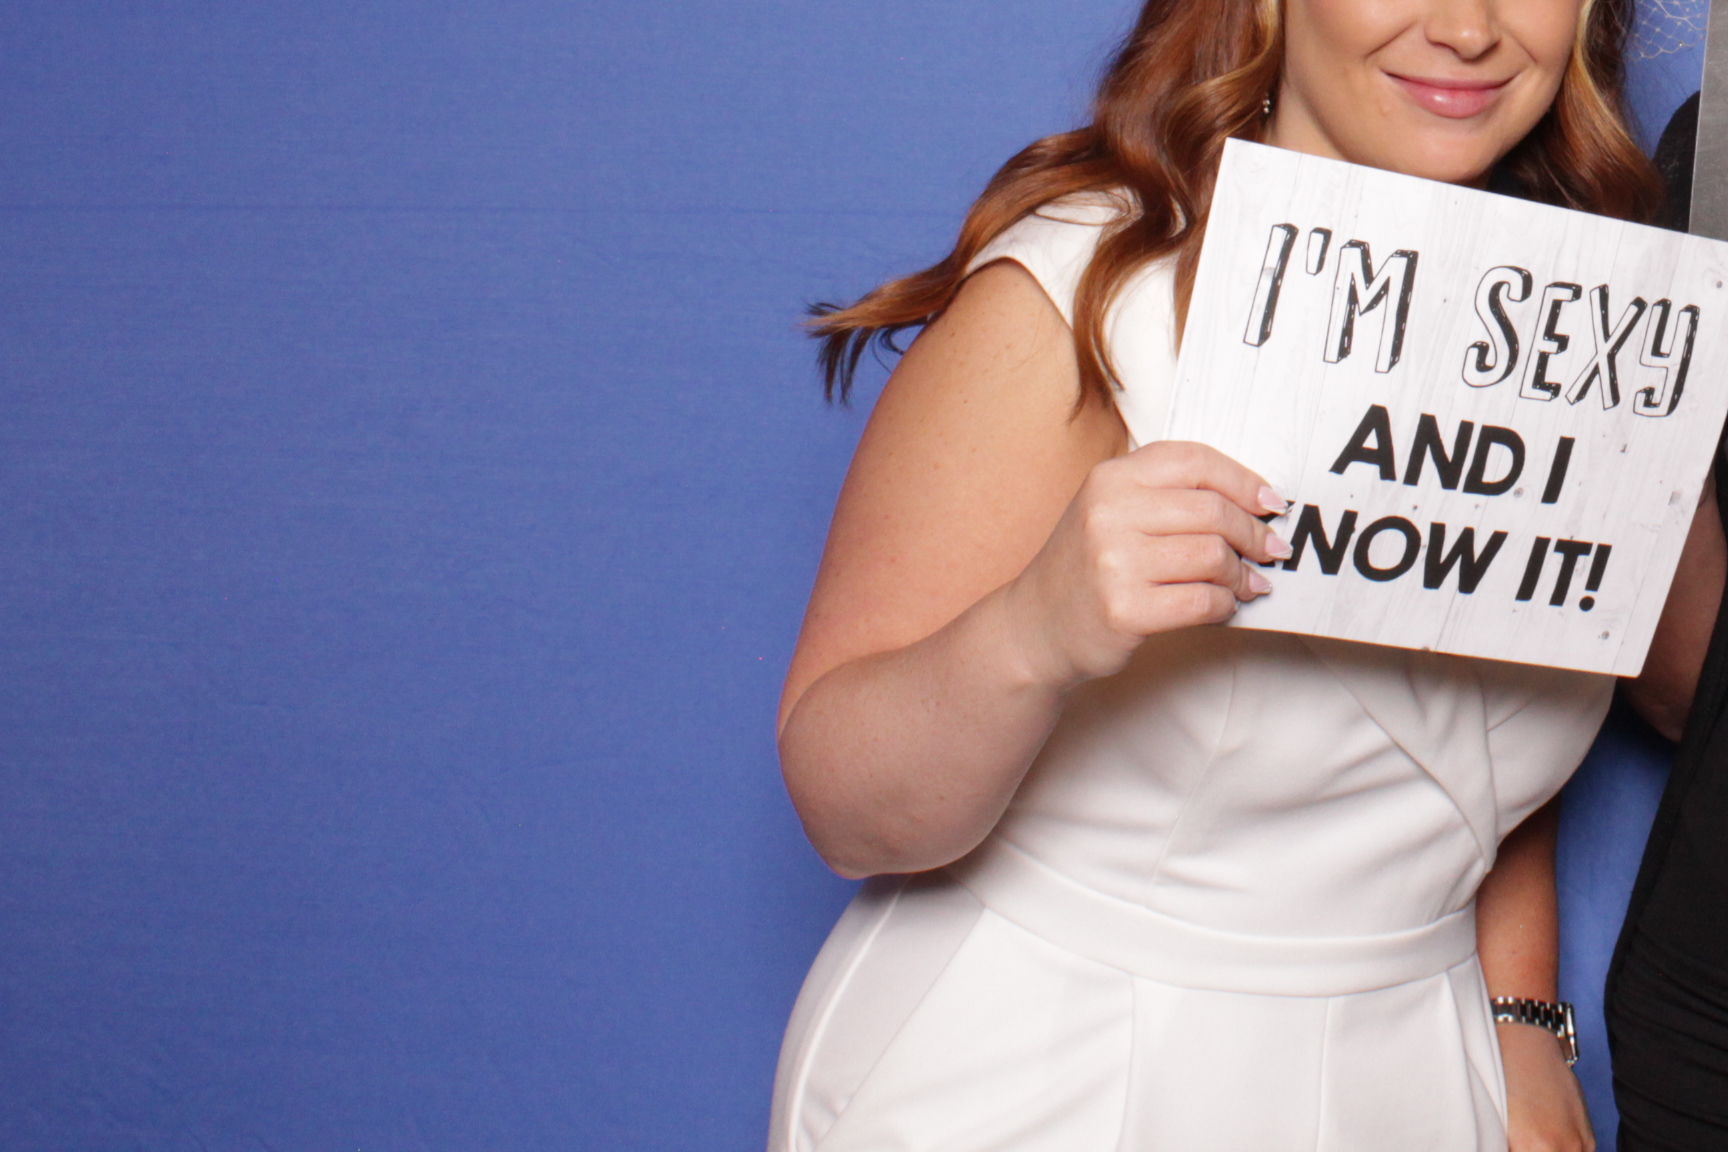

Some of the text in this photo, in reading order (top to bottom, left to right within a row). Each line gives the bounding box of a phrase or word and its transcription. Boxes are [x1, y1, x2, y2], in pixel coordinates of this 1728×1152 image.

[1243, 223, 1700, 417] I'M SEXY
[1329, 404, 1575, 504] AND I
[1240, 499, 1612, 612] NOW IT!
